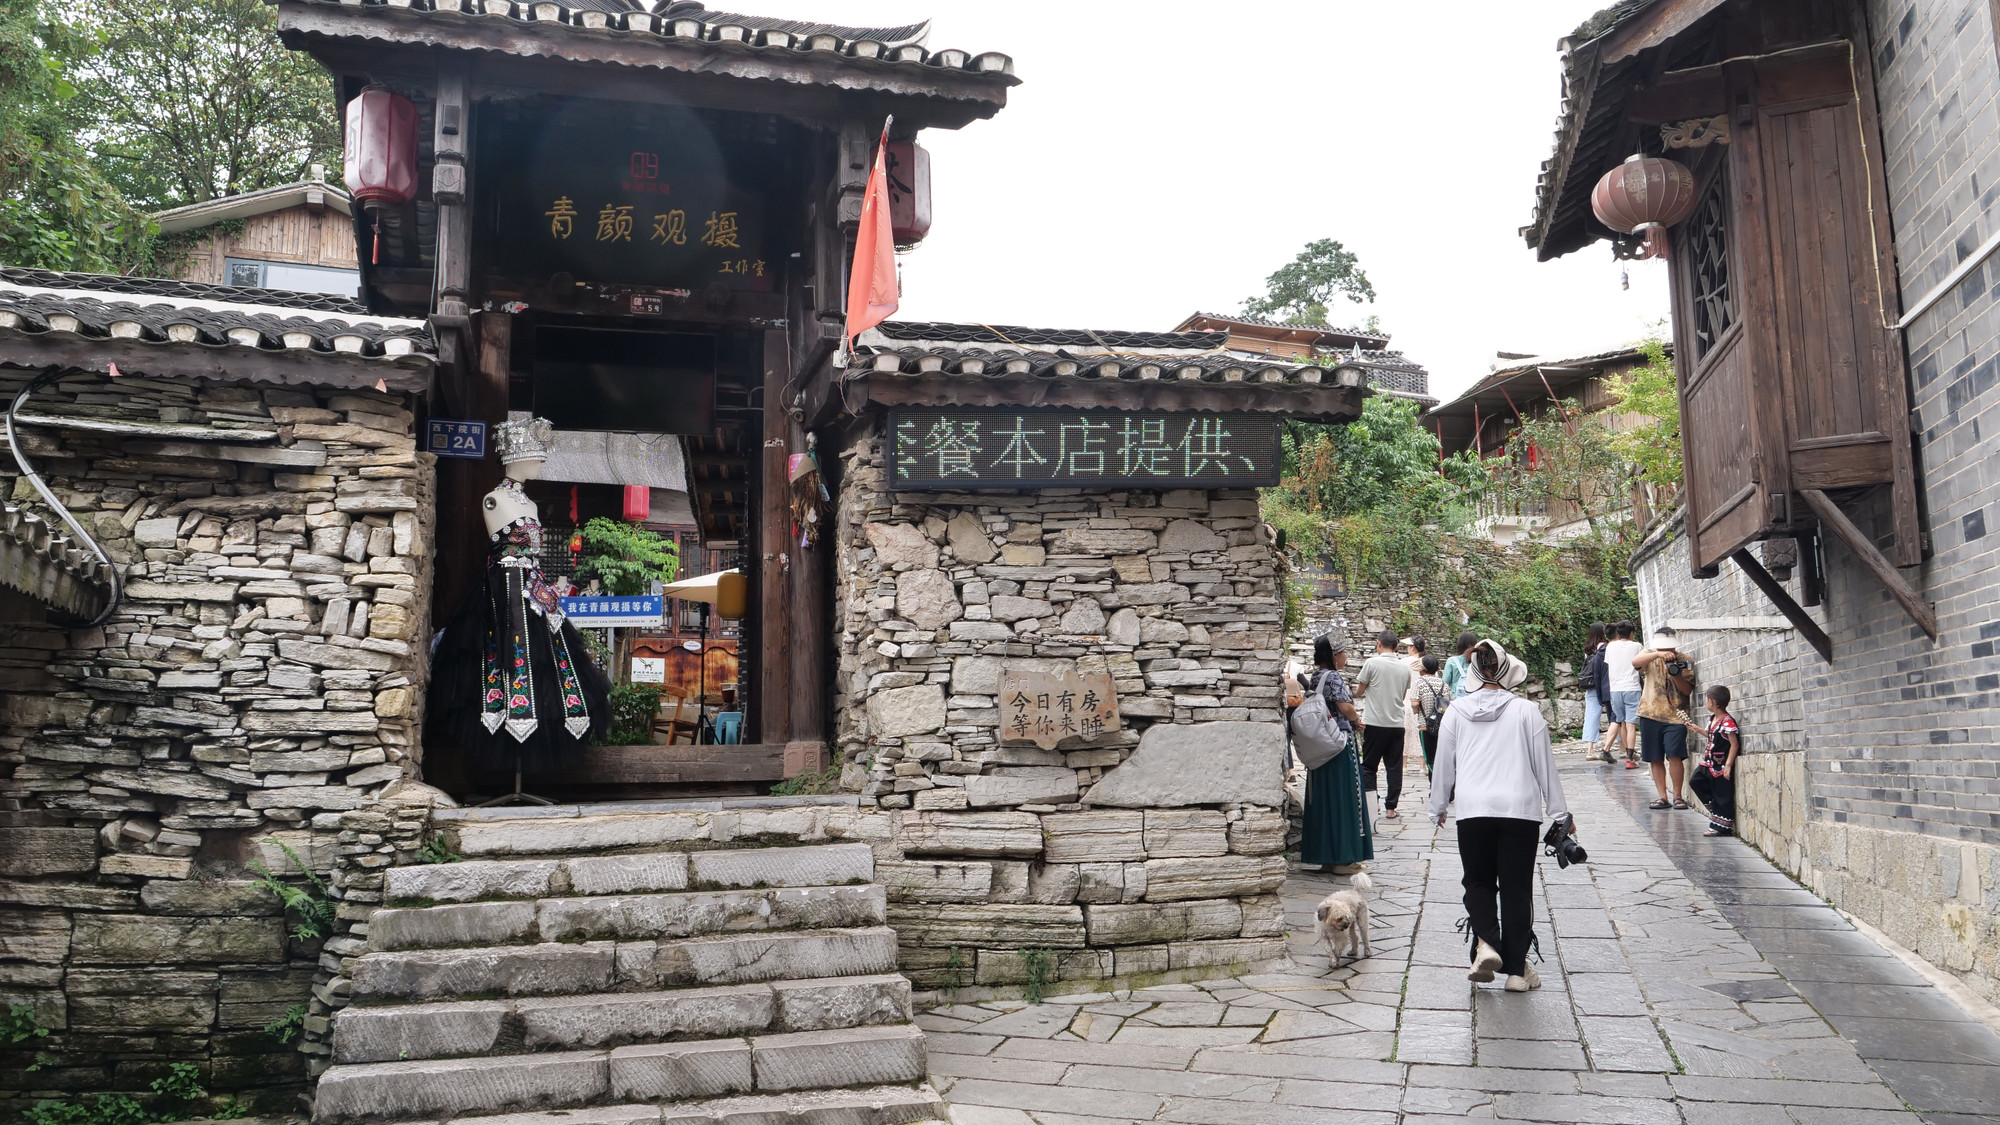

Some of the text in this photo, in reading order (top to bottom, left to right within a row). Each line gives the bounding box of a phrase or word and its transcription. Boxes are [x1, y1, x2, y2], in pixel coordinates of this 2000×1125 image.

[545, 196, 741, 248] 青颜观摄
[718, 259, 766, 277] 工作室
[432, 423, 481, 435] 西下院街
[453, 436, 477, 450] 2A
[568, 601, 652, 613] 我在青颜观摄等你
[1009, 690, 1100, 713] 今日有房
[1011, 714, 1106, 738] 等你来睡
